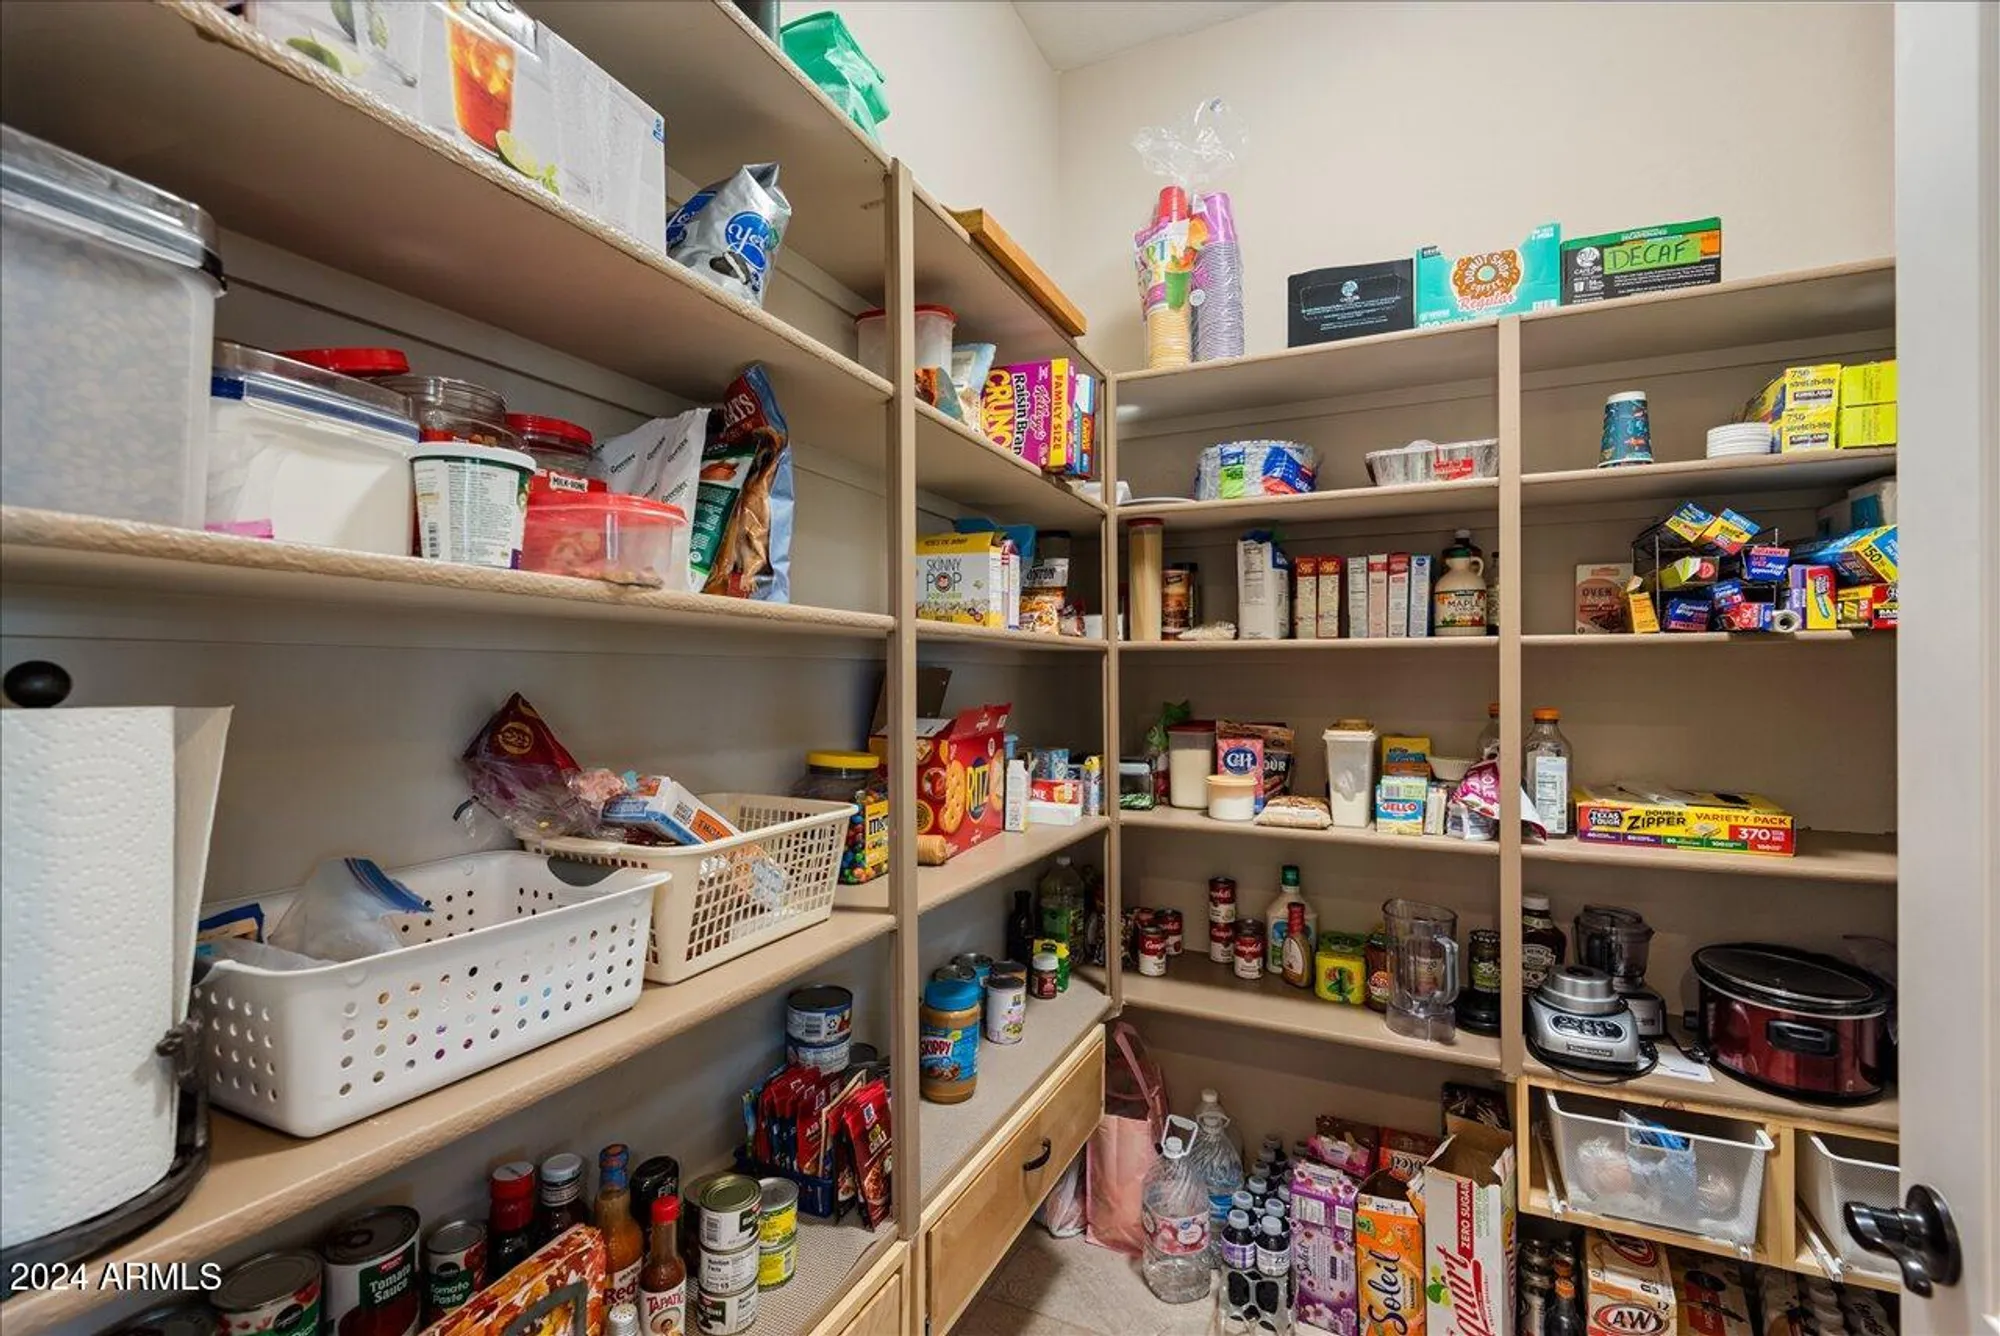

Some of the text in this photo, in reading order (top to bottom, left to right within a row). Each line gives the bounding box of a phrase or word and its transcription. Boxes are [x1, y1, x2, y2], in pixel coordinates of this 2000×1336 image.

[1607, 239, 1690, 270] DECAF
[1465, 255, 1511, 284] DONUT SHOP
[1458, 292, 1515, 310] Regular
[983, 369, 1014, 450] CRUNC
[1013, 374, 1030, 455] Raisin Bran
[1031, 384, 1051, 440] Kellogg's
[1053, 375, 1064, 450] FAMILY SIZE
[1862, 545, 1882, 561] 150
[926, 557, 962, 572] SKINNY
[926, 572, 962, 593] POP
[1582, 588, 1612, 597] OVEN
[1447, 600, 1480, 608] MAPLE
[1263, 760, 1286, 772] OUR
[966, 762, 990, 810] RITZ
[1591, 811, 1619, 819] TEXAS
[1591, 818, 1621, 826] TOUGH
[1627, 815, 1686, 831] ZIPPER
[1695, 813, 1788, 826] VARIETY PACK
[1738, 828, 1771, 841] 370
[1460, 1182, 1472, 1249] ZERO SUGAR
[369, 1264, 412, 1293] Tomato
[430, 1279, 471, 1294] Tomato
[374, 1279, 409, 1304] Sauce
[602, 1279, 637, 1305] Red
[1367, 1250, 1408, 1336] Soleil
[1436, 1244, 1494, 1336] quirt
[1657, 1301, 1670, 1311] 12
